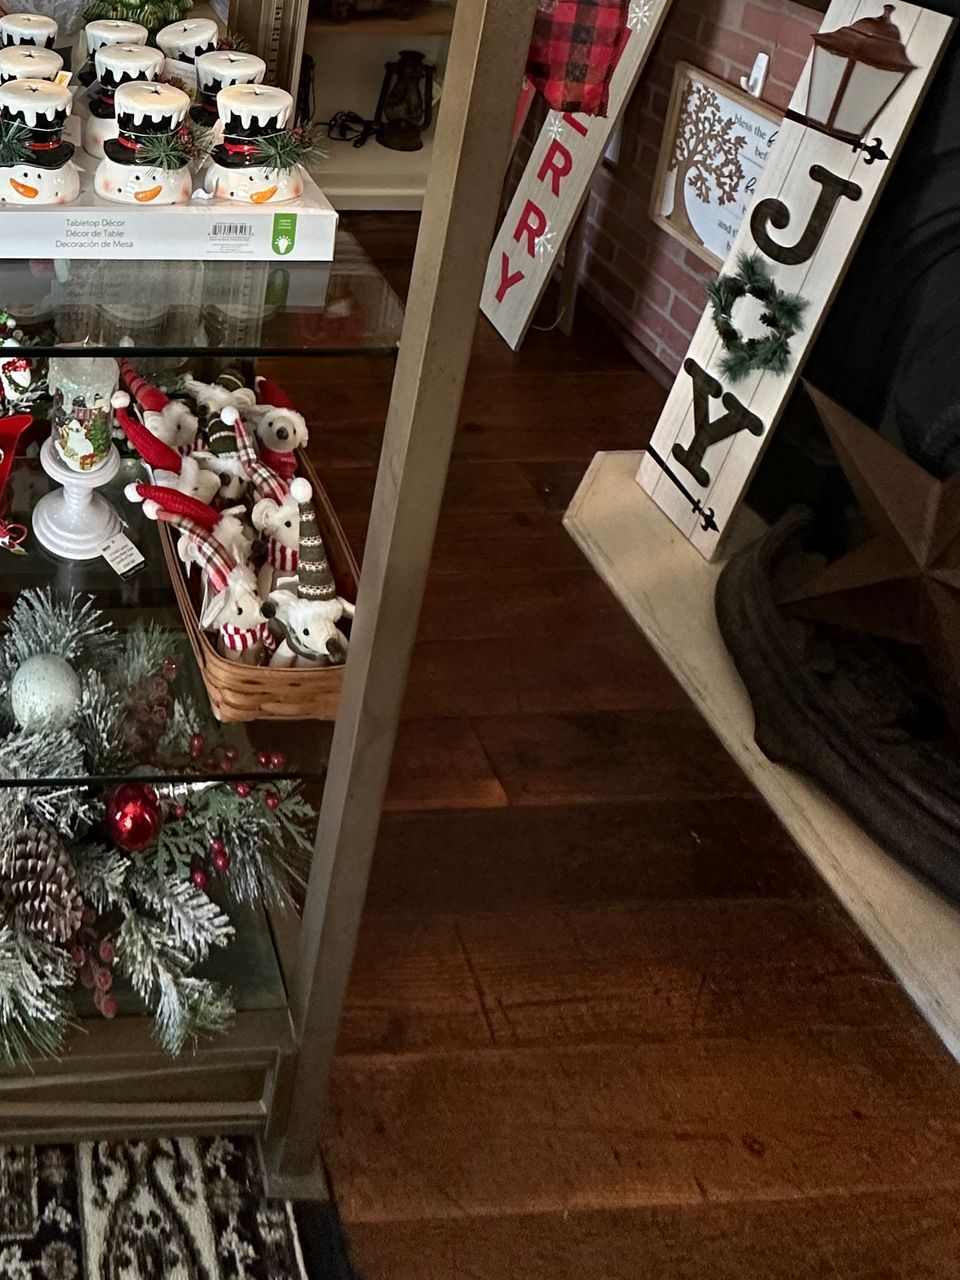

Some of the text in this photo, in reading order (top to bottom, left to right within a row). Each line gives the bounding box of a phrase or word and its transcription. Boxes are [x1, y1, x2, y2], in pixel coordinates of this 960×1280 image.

[733, 113, 753, 132] bless
[754, 126, 767, 140] the
[65, 217, 126, 229] Tabletop Décor
[66, 228, 124, 238] Décor de Table
[55, 239, 134, 249] Decoración de Mesa
